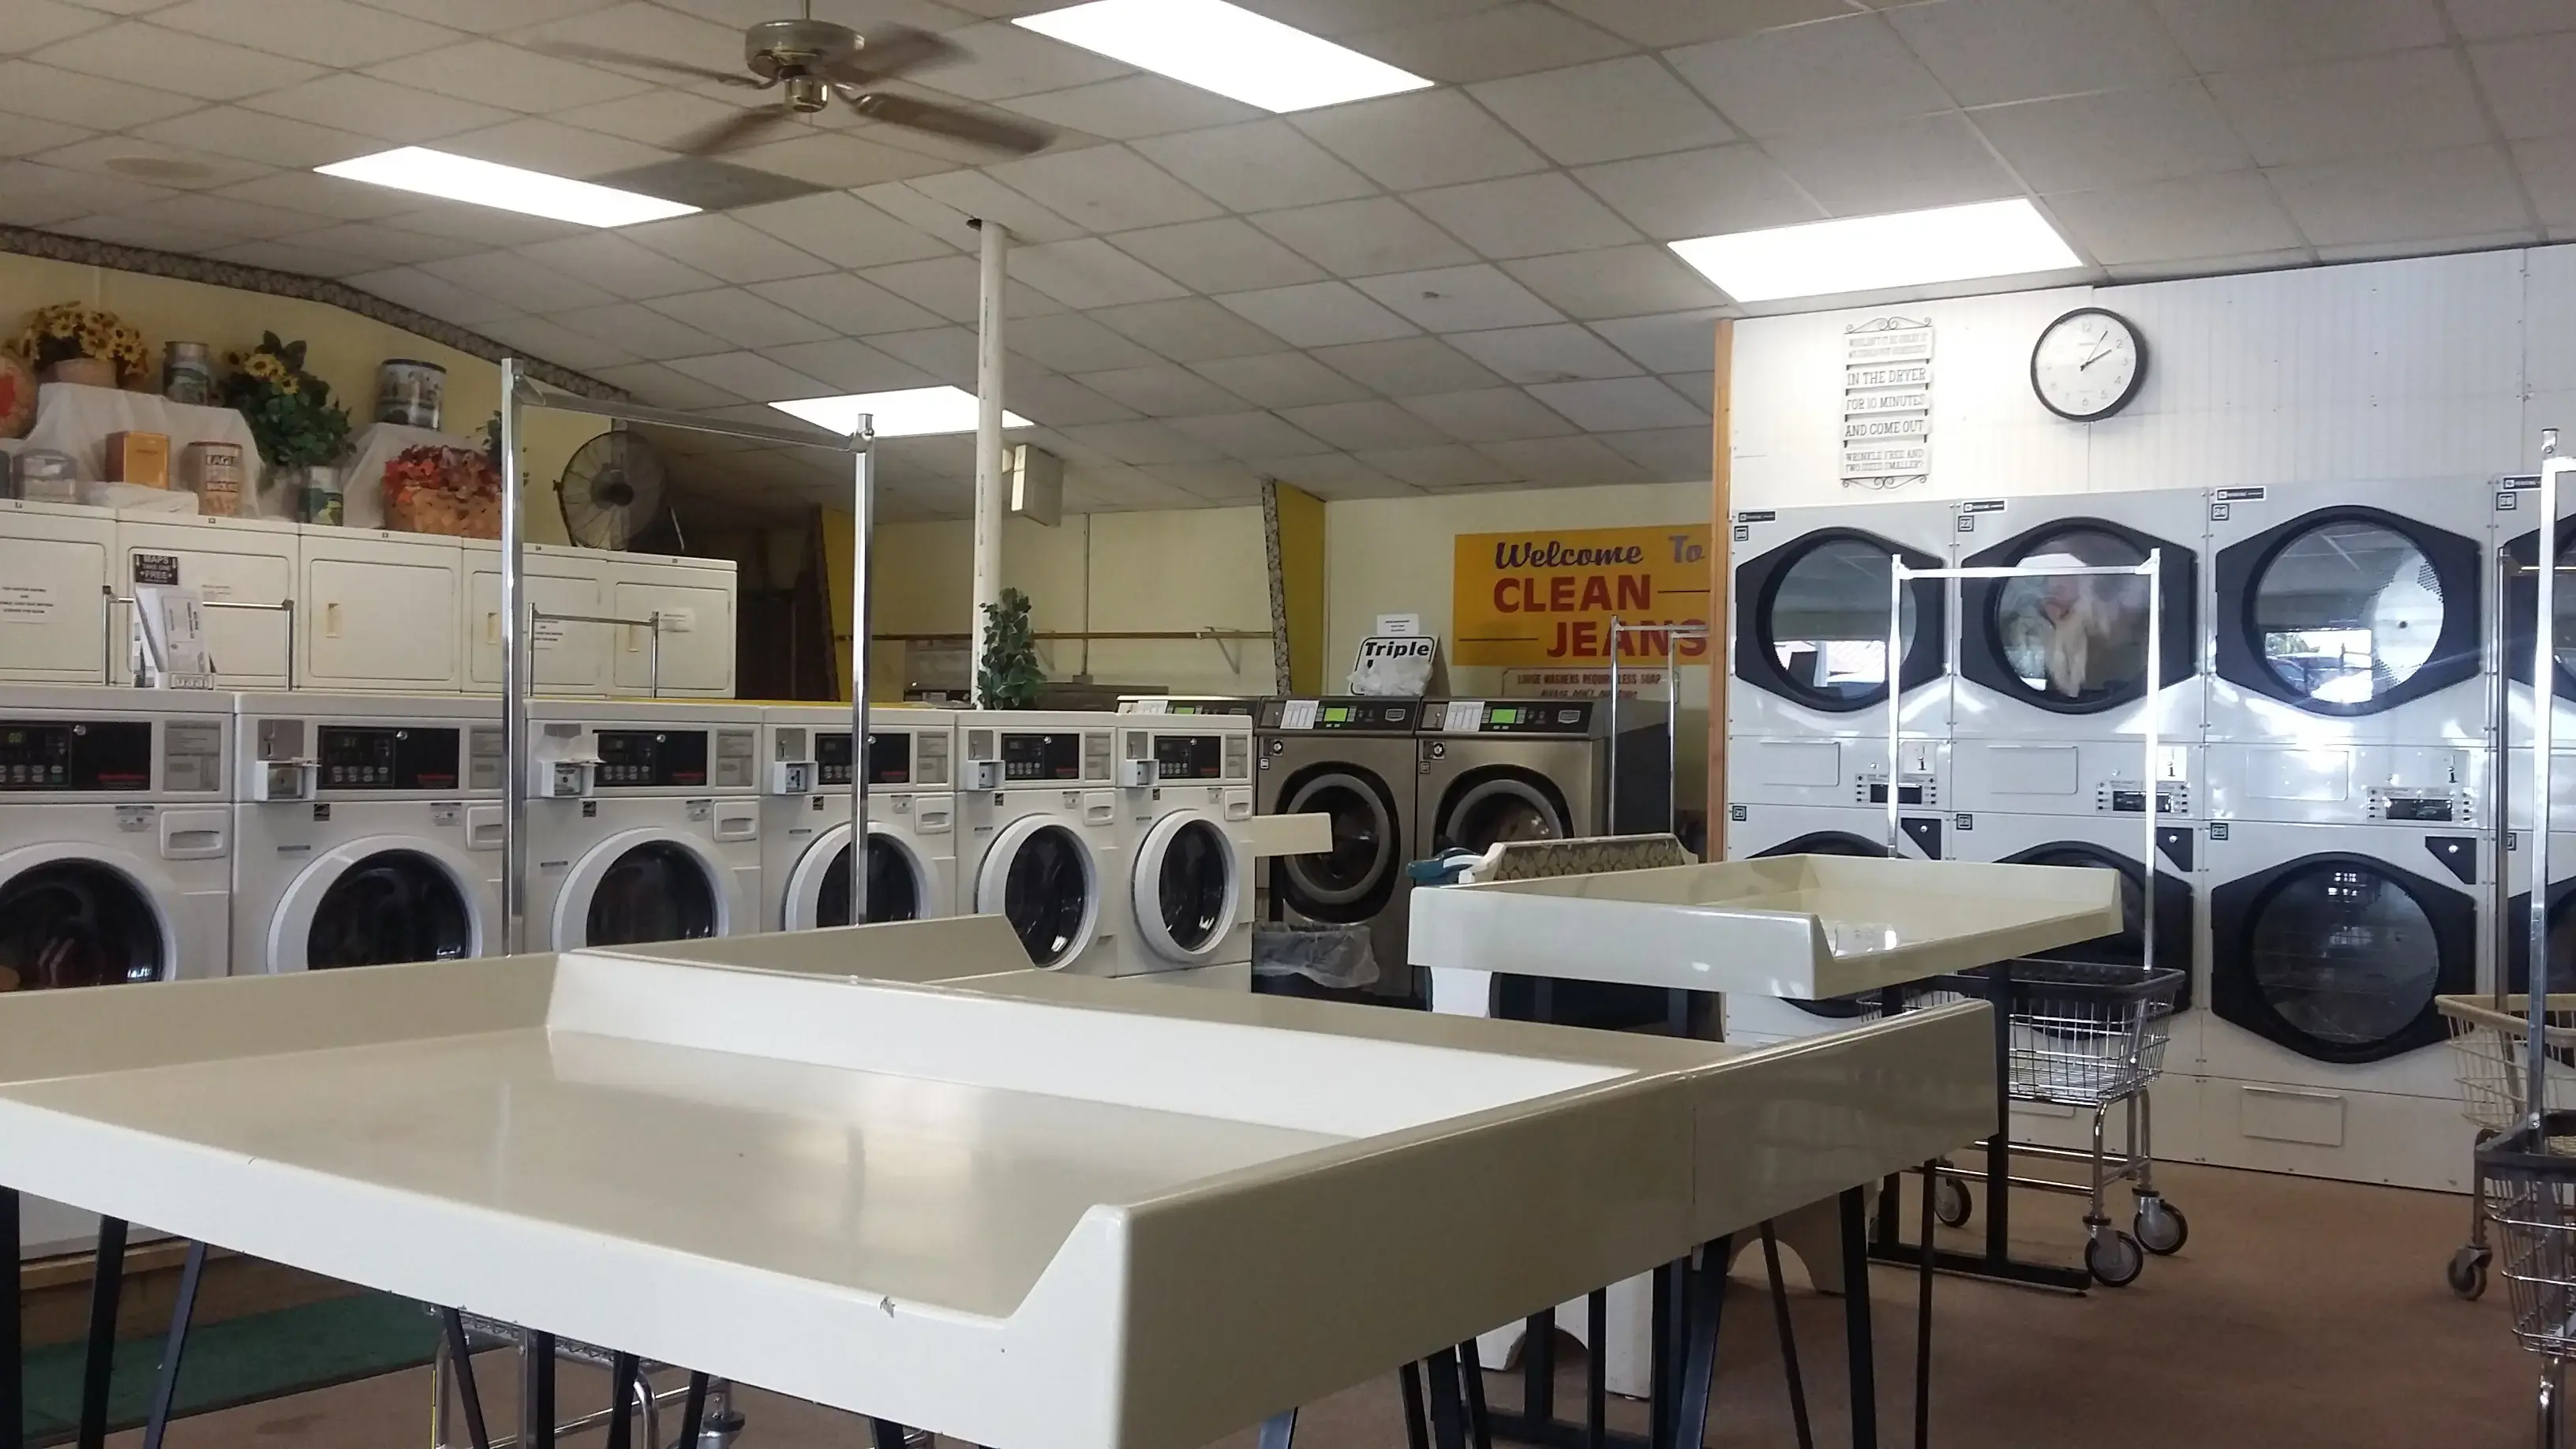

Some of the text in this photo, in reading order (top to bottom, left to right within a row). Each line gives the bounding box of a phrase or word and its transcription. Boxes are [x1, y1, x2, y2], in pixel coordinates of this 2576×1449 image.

[2115, 339, 2123, 349] 2
[1847, 368, 1926, 386] IN THE DRYER
[1846, 394, 1926, 410] FOR 10 MINUTES
[1844, 420, 1924, 437] AND COME OUT
[1907, 448, 1925, 459] AND
[1495, 534, 1706, 570] Welcome To
[1493, 574, 1651, 613] CLEAN
[1547, 619, 1707, 658] JEANS
[1365, 641, 1429, 659] Triple
